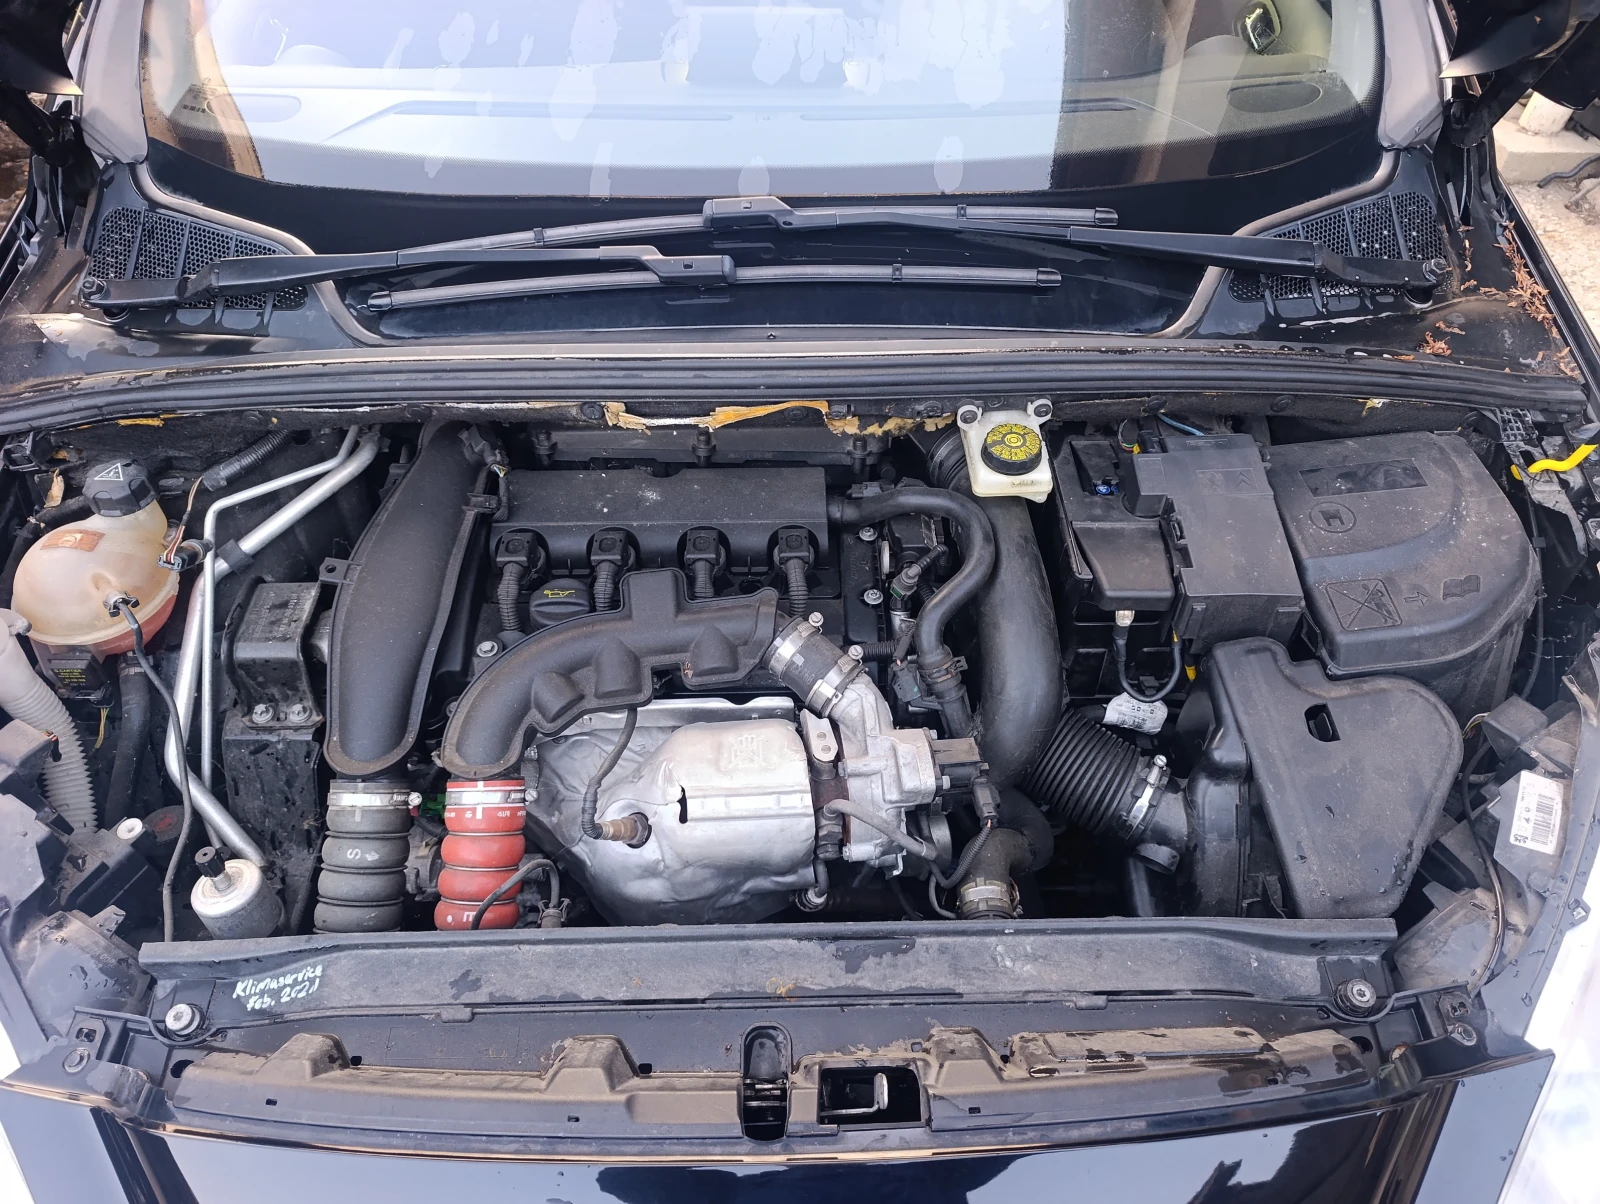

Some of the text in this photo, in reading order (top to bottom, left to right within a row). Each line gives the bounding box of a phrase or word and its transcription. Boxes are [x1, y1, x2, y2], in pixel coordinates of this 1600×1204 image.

[232, 965, 323, 999] Klimaservice
[246, 978, 320, 1012] Feb. 2021
